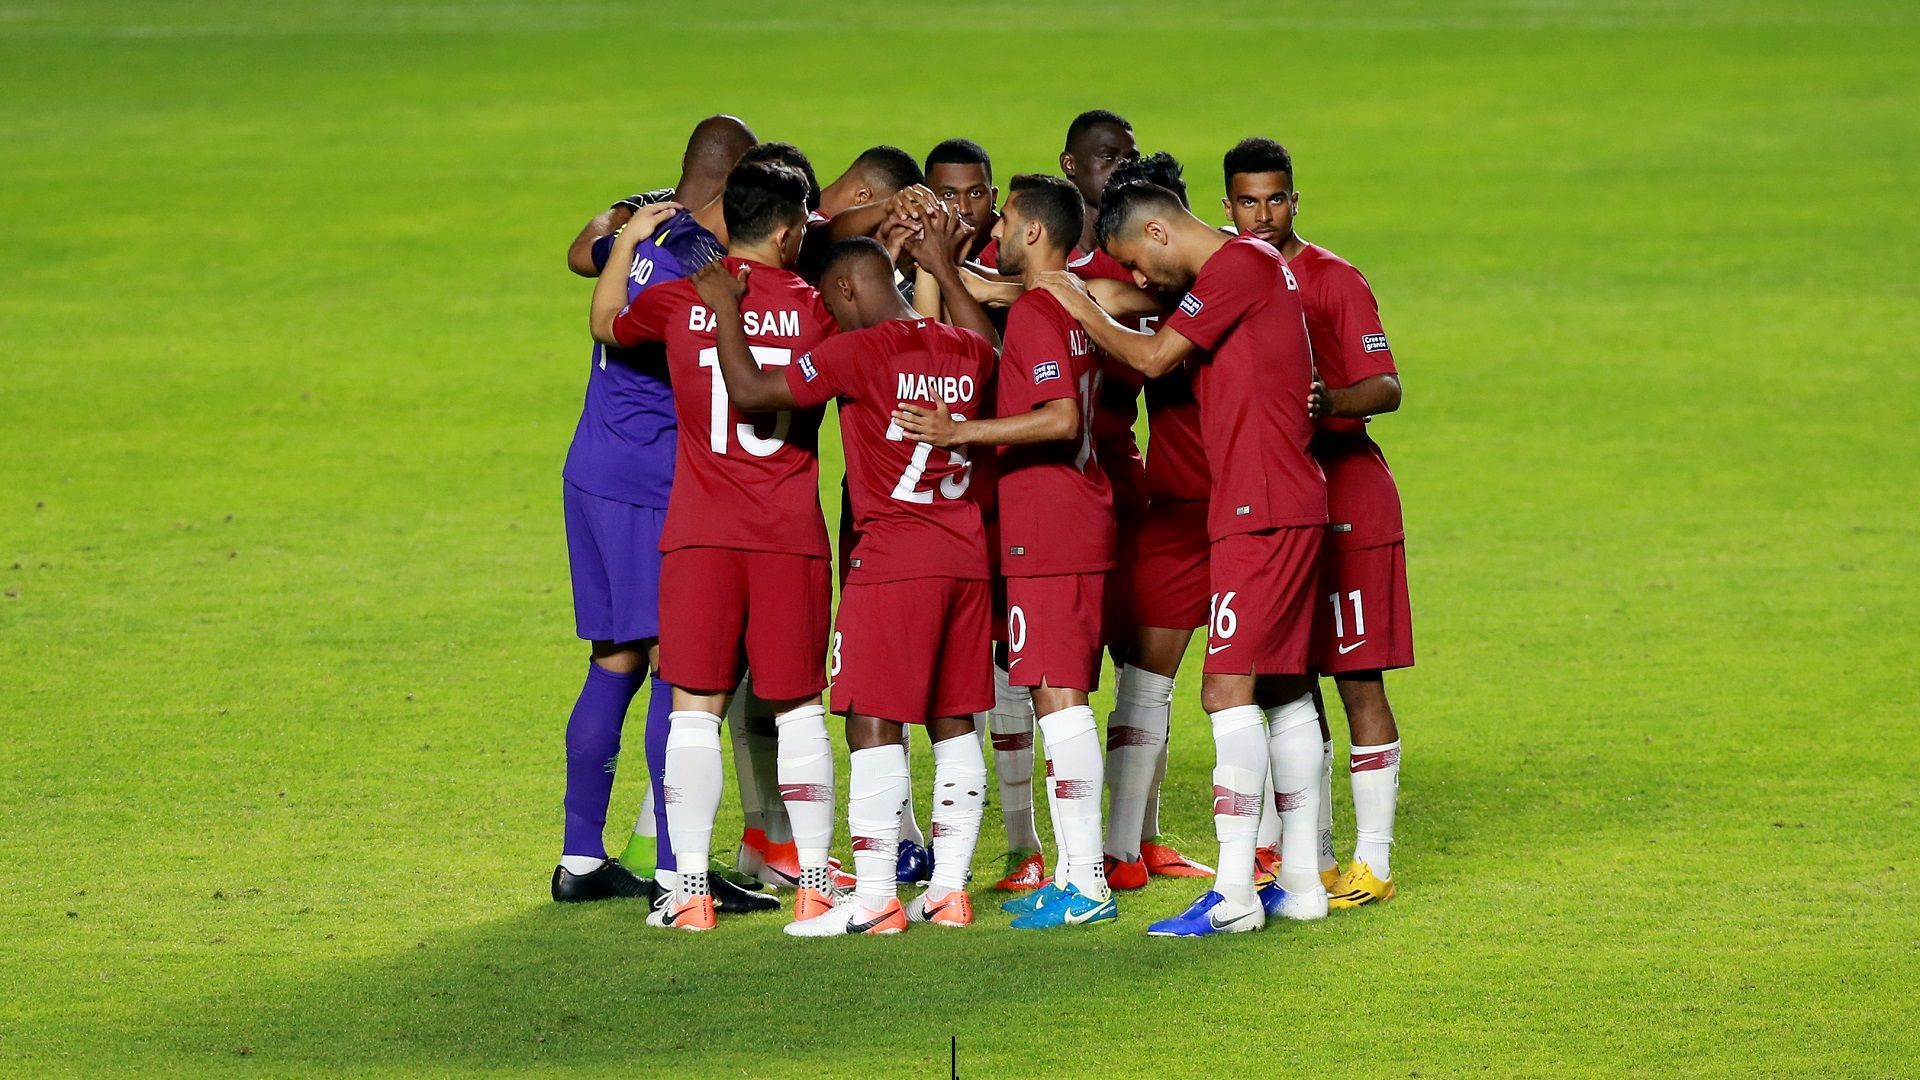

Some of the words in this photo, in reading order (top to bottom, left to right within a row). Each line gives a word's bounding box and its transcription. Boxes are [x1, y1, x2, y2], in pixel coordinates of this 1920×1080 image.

[688, 305, 800, 337] BASAM
[699, 346, 792, 458] 15
[886, 411, 973, 504] 23
[1008, 605, 1027, 653] 0
[1209, 591, 1237, 639] 16
[1329, 589, 1365, 638] 11
